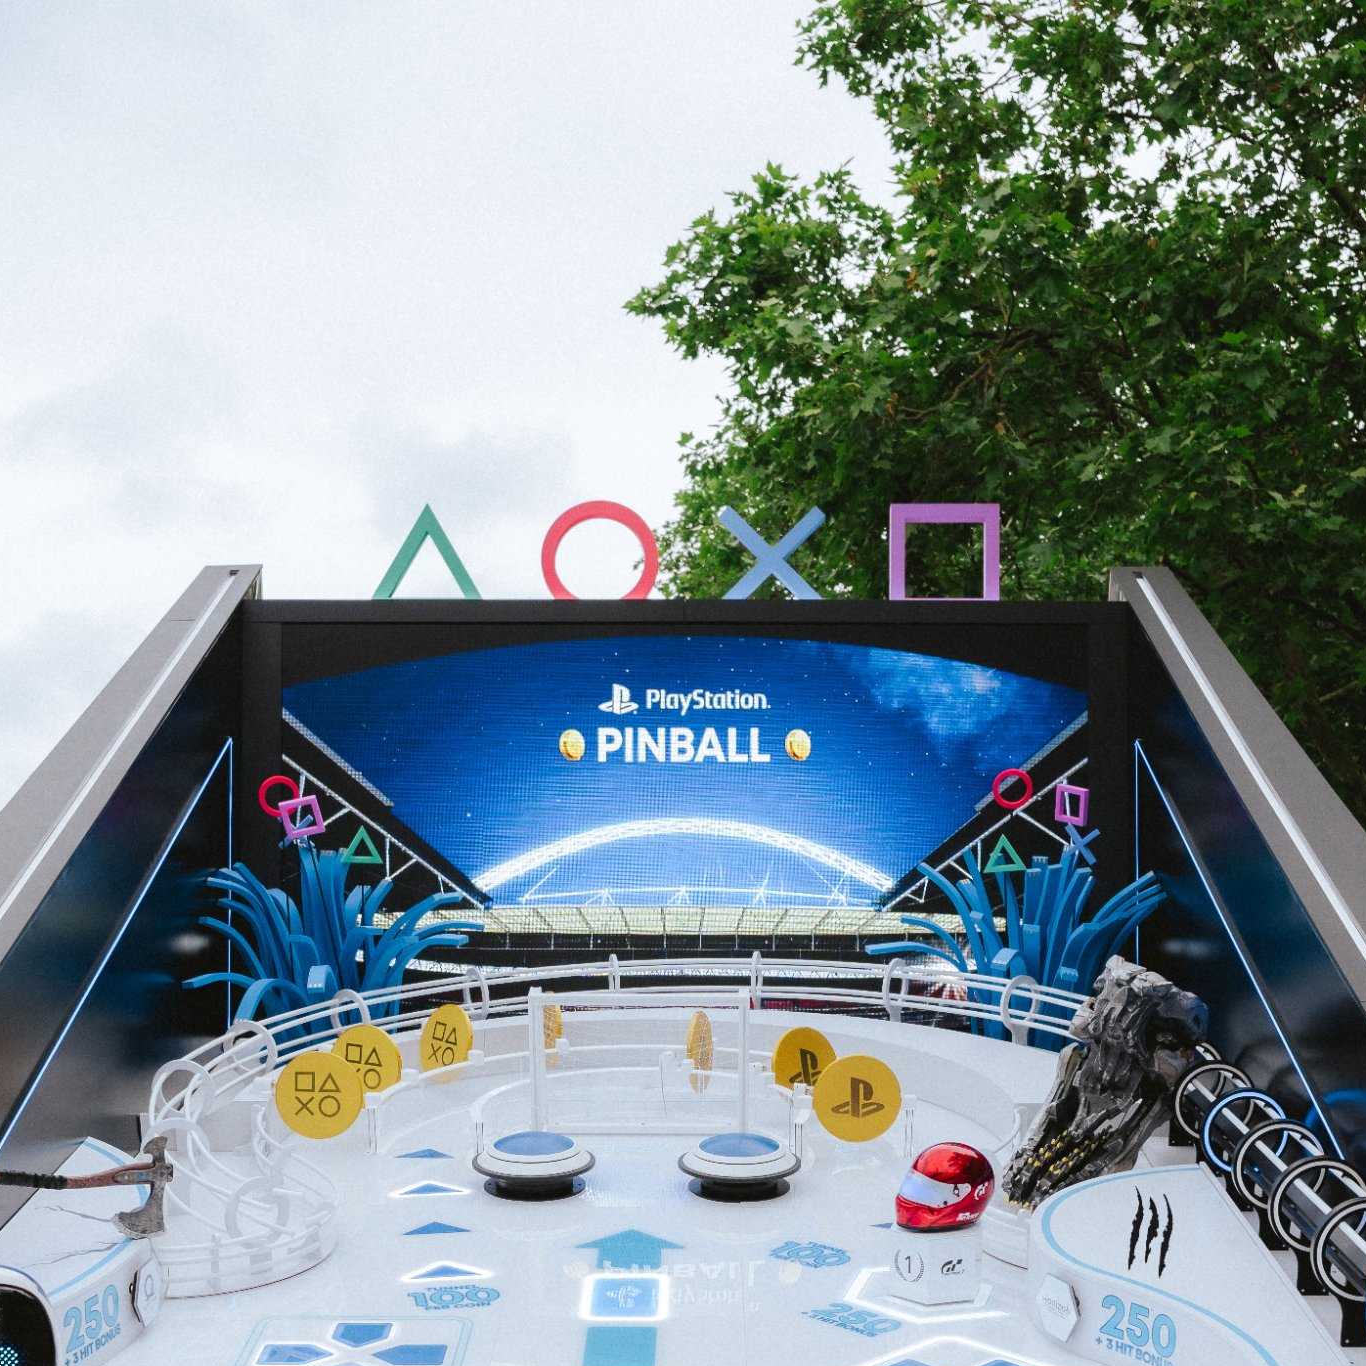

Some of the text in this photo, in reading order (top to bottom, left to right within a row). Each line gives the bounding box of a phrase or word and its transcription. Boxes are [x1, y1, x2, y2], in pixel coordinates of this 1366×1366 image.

[597, 727, 771, 763] PINBALL
[407, 1287, 501, 1308] 100
[63, 1284, 119, 1353] 250
[810, 1302, 902, 1334] 250
[1098, 1294, 1177, 1358] 250
[80, 1342, 94, 1360] HIT
[95, 1323, 121, 1350] BONUS
[1106, 1338, 1113, 1350] 3
[1115, 1340, 1135, 1358] HIT
